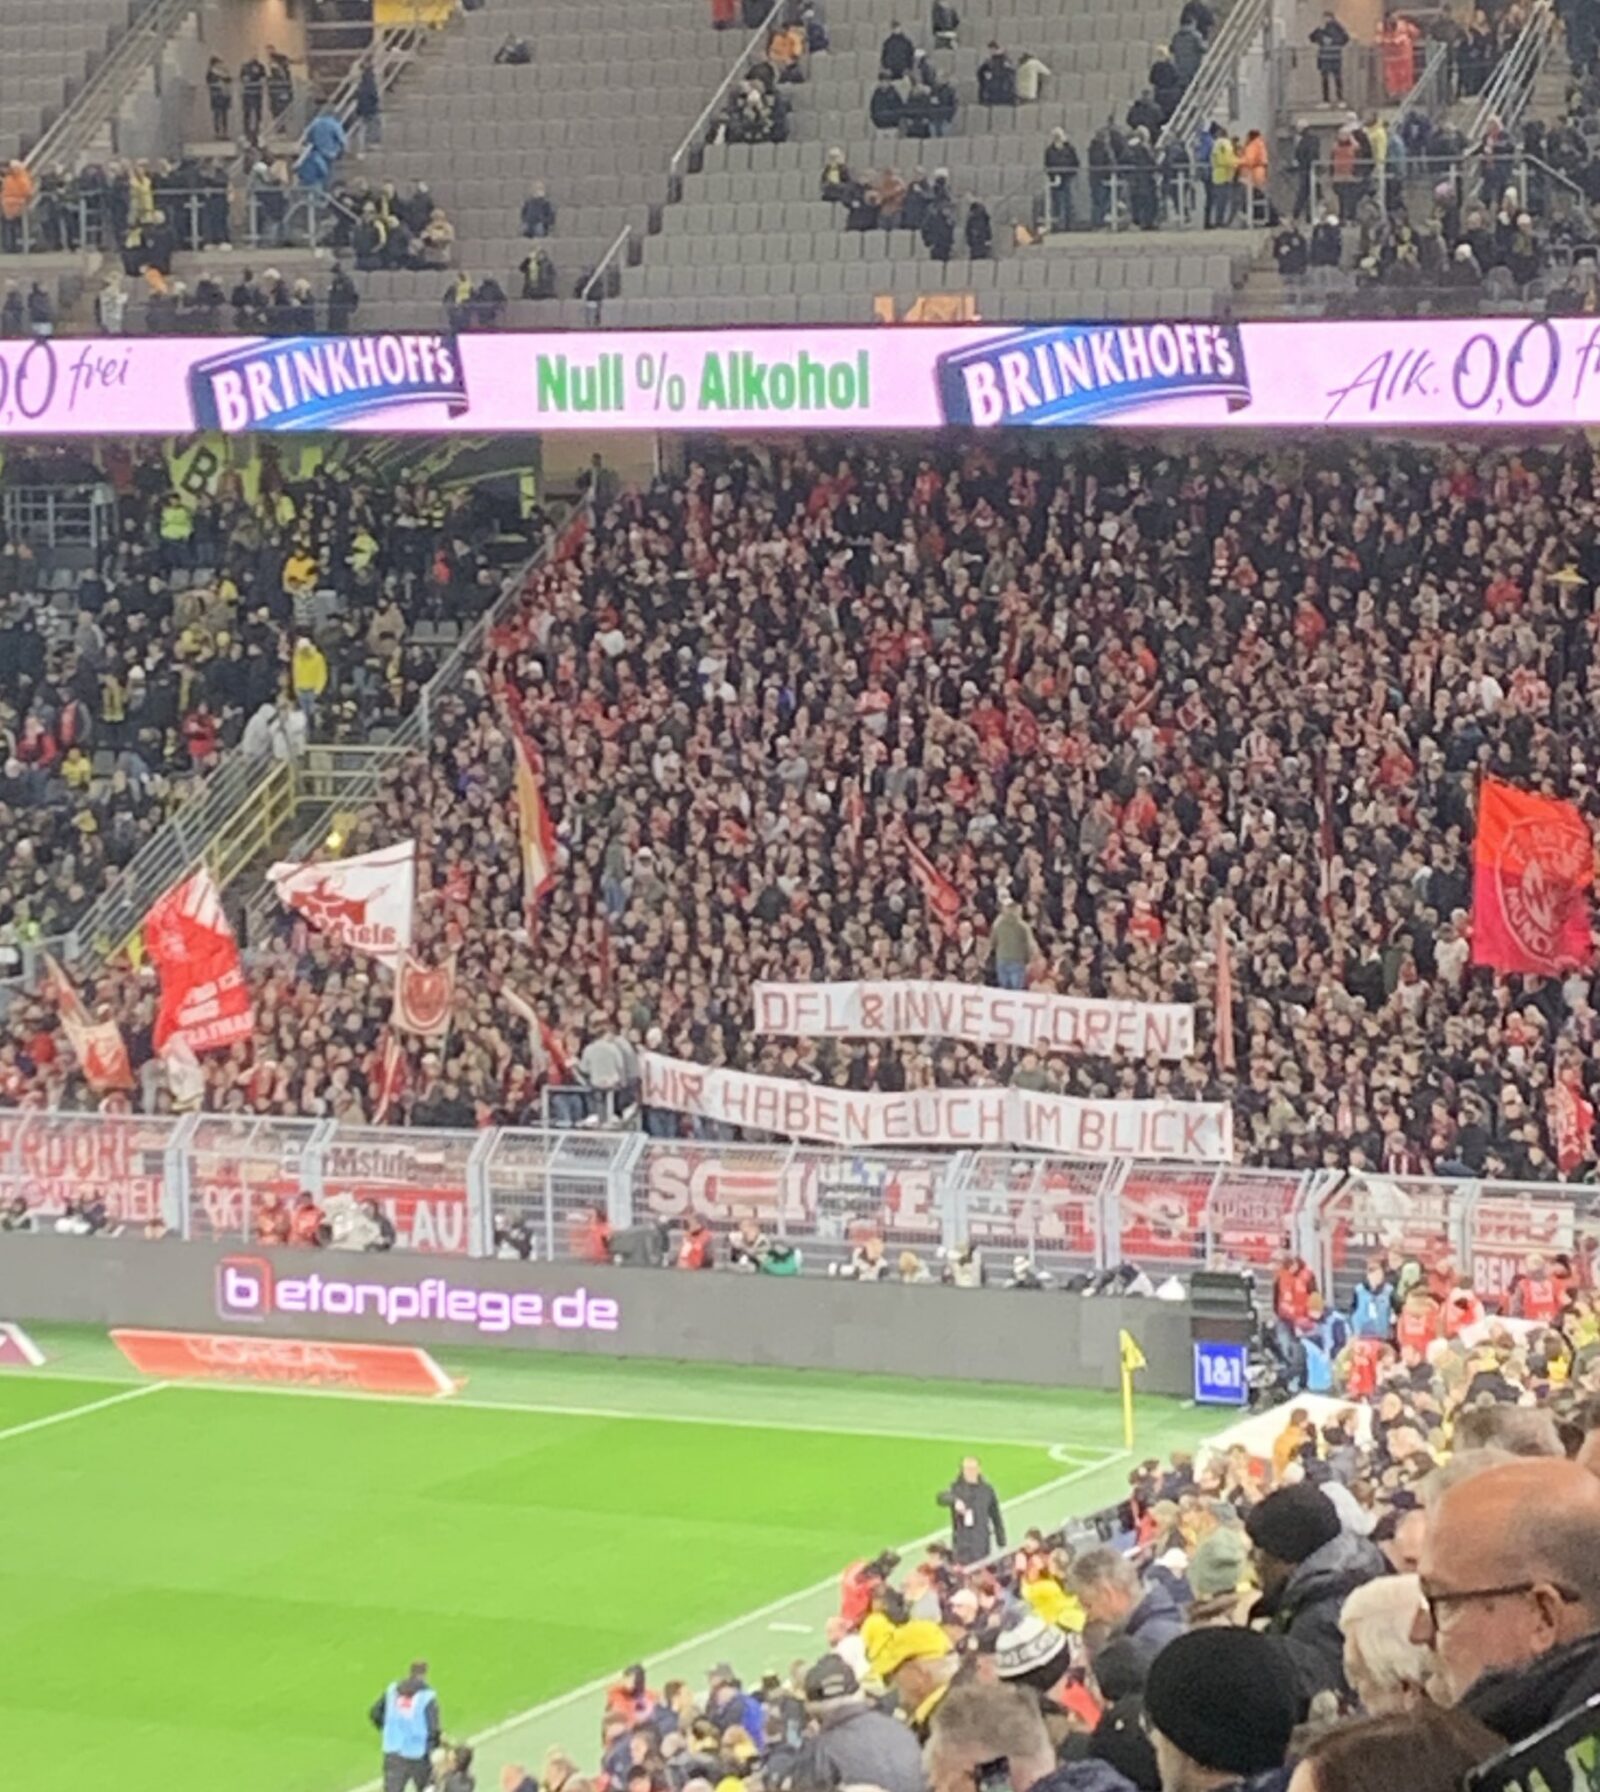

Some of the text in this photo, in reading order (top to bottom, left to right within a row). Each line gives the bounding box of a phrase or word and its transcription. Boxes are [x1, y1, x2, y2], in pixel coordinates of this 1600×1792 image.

[69, 344, 133, 411] frei
[536, 350, 870, 411] Null % Alkohol
[1325, 350, 1439, 420] Alk.
[762, 991, 848, 1031] DFL
[645, 1061, 1225, 1155] WIR HABEN EUCH IM BLICK!
[1201, 1354, 1241, 1388] 1&1
